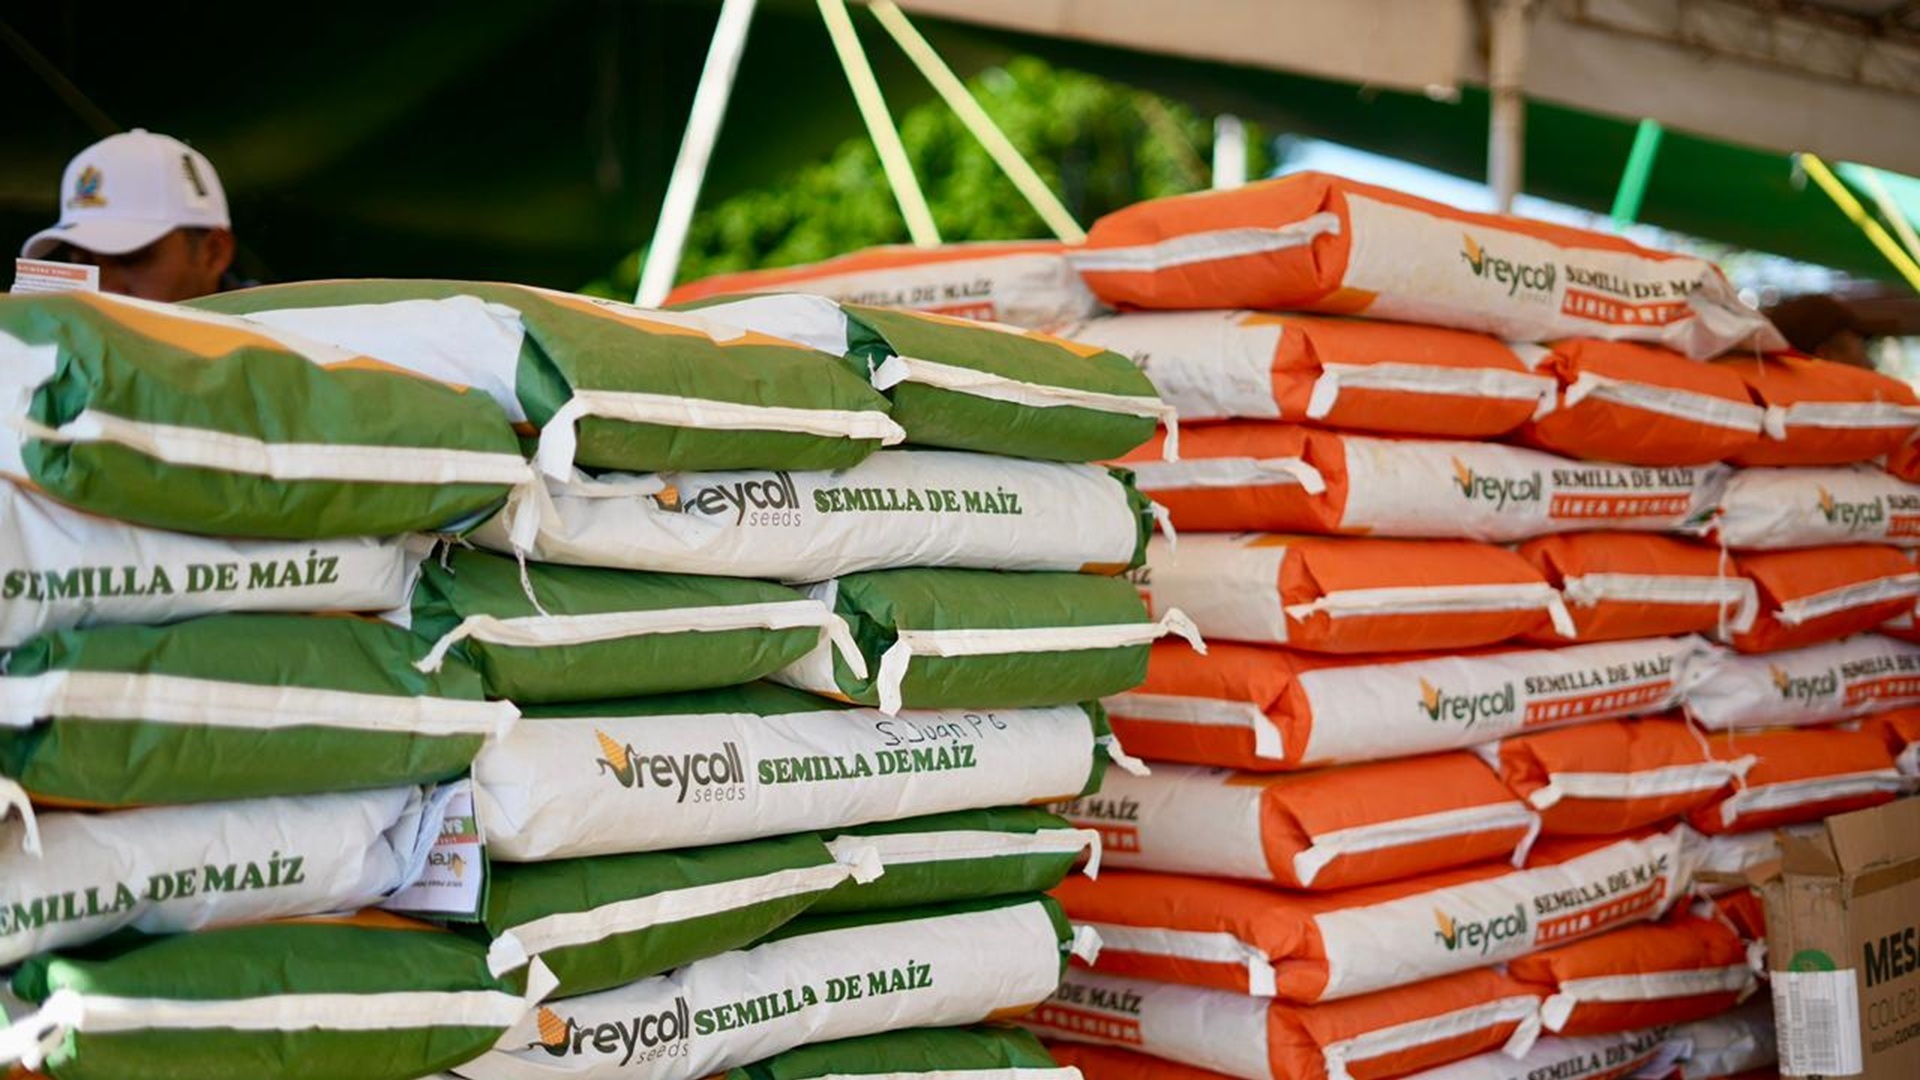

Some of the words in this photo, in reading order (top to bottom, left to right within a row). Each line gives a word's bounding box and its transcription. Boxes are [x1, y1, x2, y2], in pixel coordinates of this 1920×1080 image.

[1633, 280, 1665, 298] DE
[1552, 469, 1628, 487] SEMILLA
[1631, 470, 1655, 487] DE
[813, 487, 924, 514] SEMILLA
[926, 490, 961, 513] DE
[962, 486, 1022, 515] MAÍZ
[750, 510, 801, 527] seeds
[2, 565, 173, 601] SEMILLA
[186, 563, 239, 593] DE
[247, 550, 339, 590] MAÍZ
[1524, 669, 1602, 694] SEMILLA
[1607, 664, 1630, 683] DE
[1441, 683, 1515, 729] reycoll
[635, 742, 746, 803] reycoll
[757, 753, 874, 785] SEMILLA
[693, 785, 747, 803] seeds
[1086, 794, 1140, 820] MAÍZ
[145, 868, 197, 901] DE
[202, 851, 305, 893] MAÍZ
[1534, 882, 1606, 914] SEMILLA
[1607, 870, 1631, 892] DE
[1457, 902, 1528, 954] reycoll
[1864, 926, 1920, 988] MES
[694, 985, 817, 1035] SEMILLA
[824, 977, 863, 1003] DE
[867, 960, 933, 997] MAÍZ
[1057, 982, 1086, 1004] DE
[1089, 987, 1143, 1013] MAÍZ
[573, 996, 690, 1067] reycoll
[636, 1038, 690, 1066] seeds
